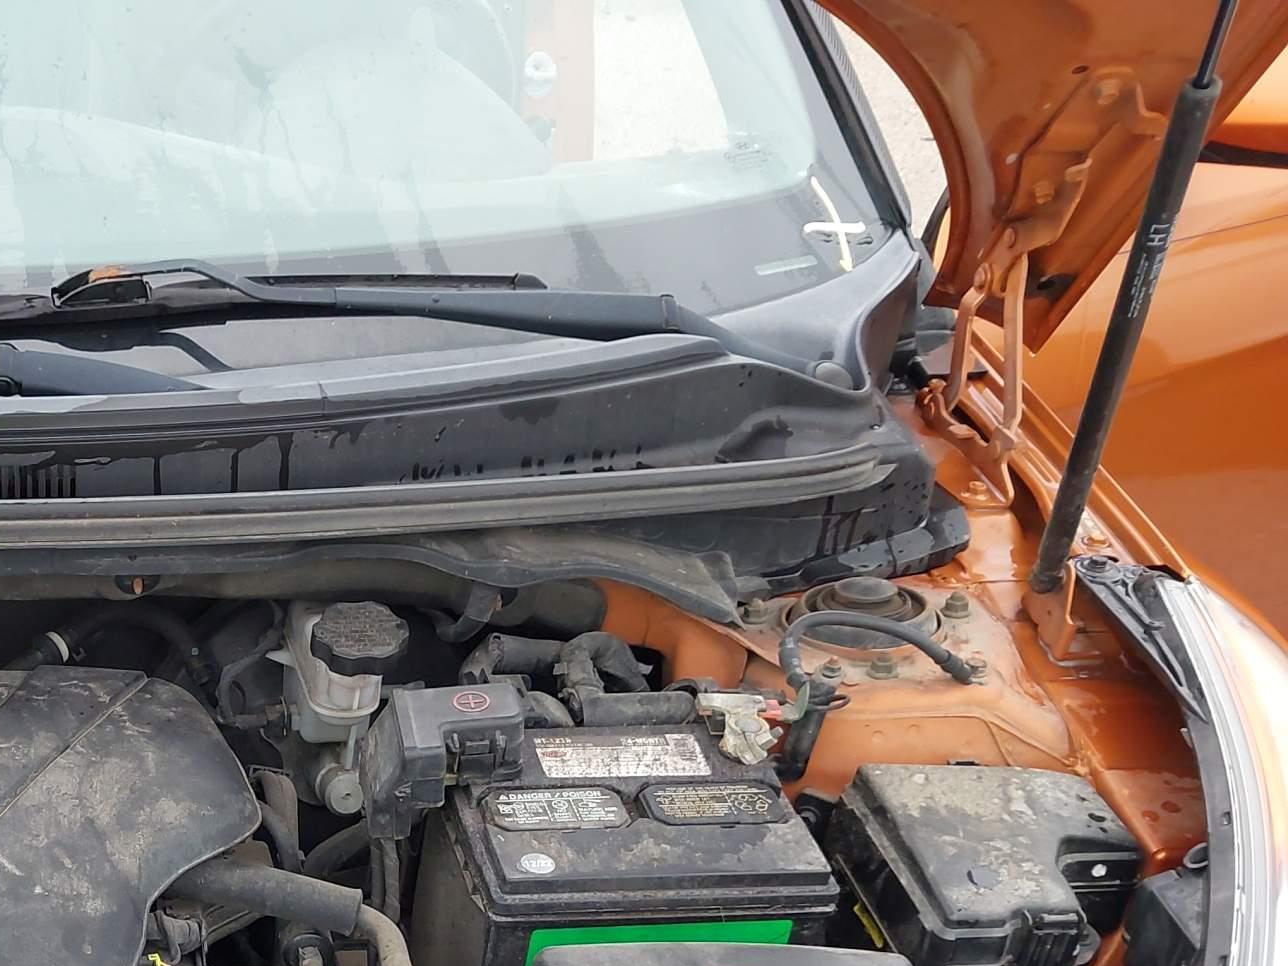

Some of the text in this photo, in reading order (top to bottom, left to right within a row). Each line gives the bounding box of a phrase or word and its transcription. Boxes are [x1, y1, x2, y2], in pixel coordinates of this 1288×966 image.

[1146, 223, 1171, 246] LH
[509, 792, 552, 800] DANGER
[562, 790, 601, 799] POISON
